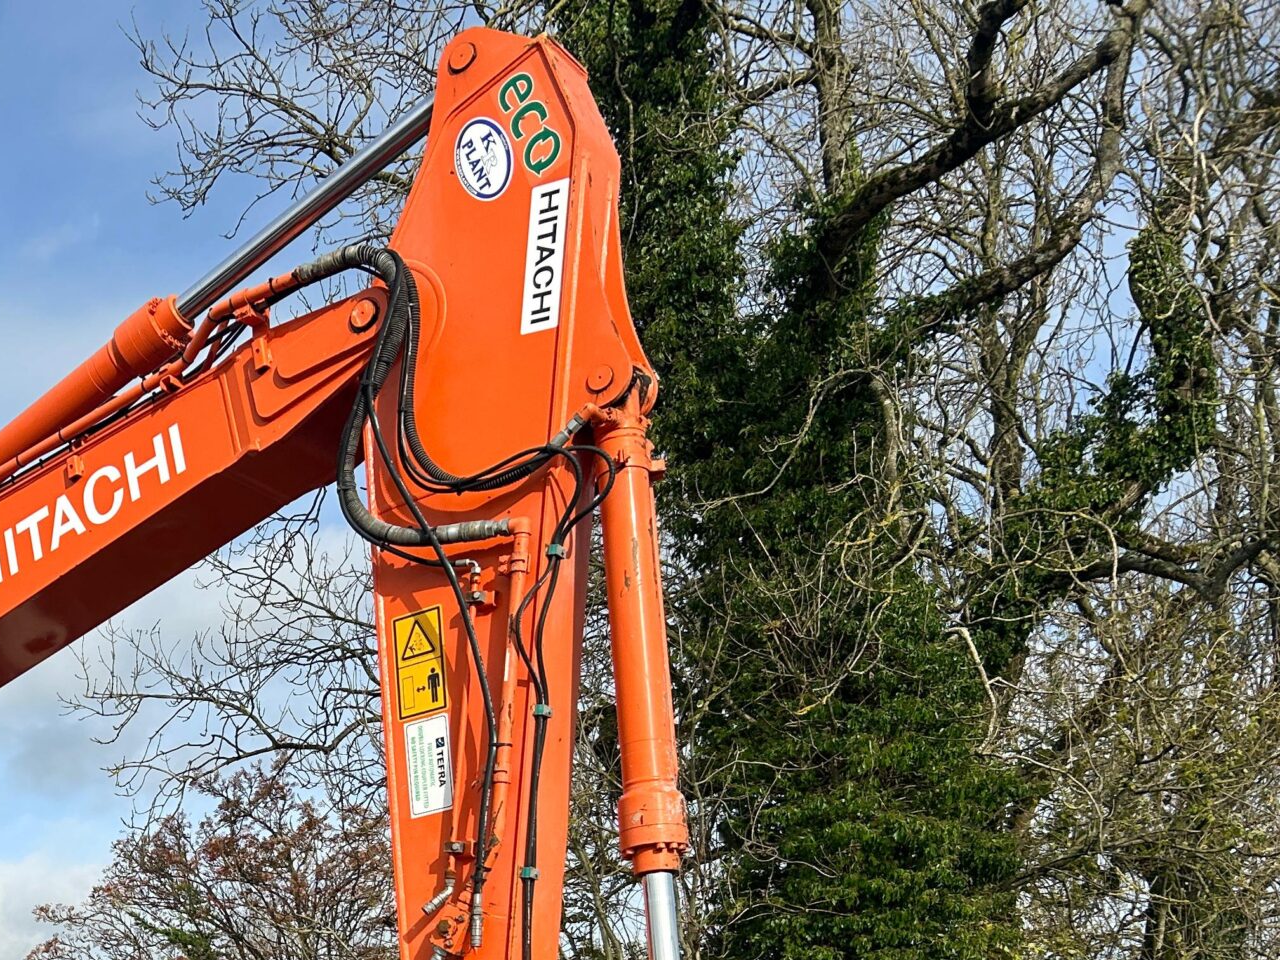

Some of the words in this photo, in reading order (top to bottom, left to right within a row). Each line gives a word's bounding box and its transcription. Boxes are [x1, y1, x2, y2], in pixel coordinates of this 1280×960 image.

[499, 73, 561, 176] eco
[462, 139, 491, 191] PLANT
[530, 188, 560, 325] HITACHI
[436, 749, 447, 788] TEFRA
